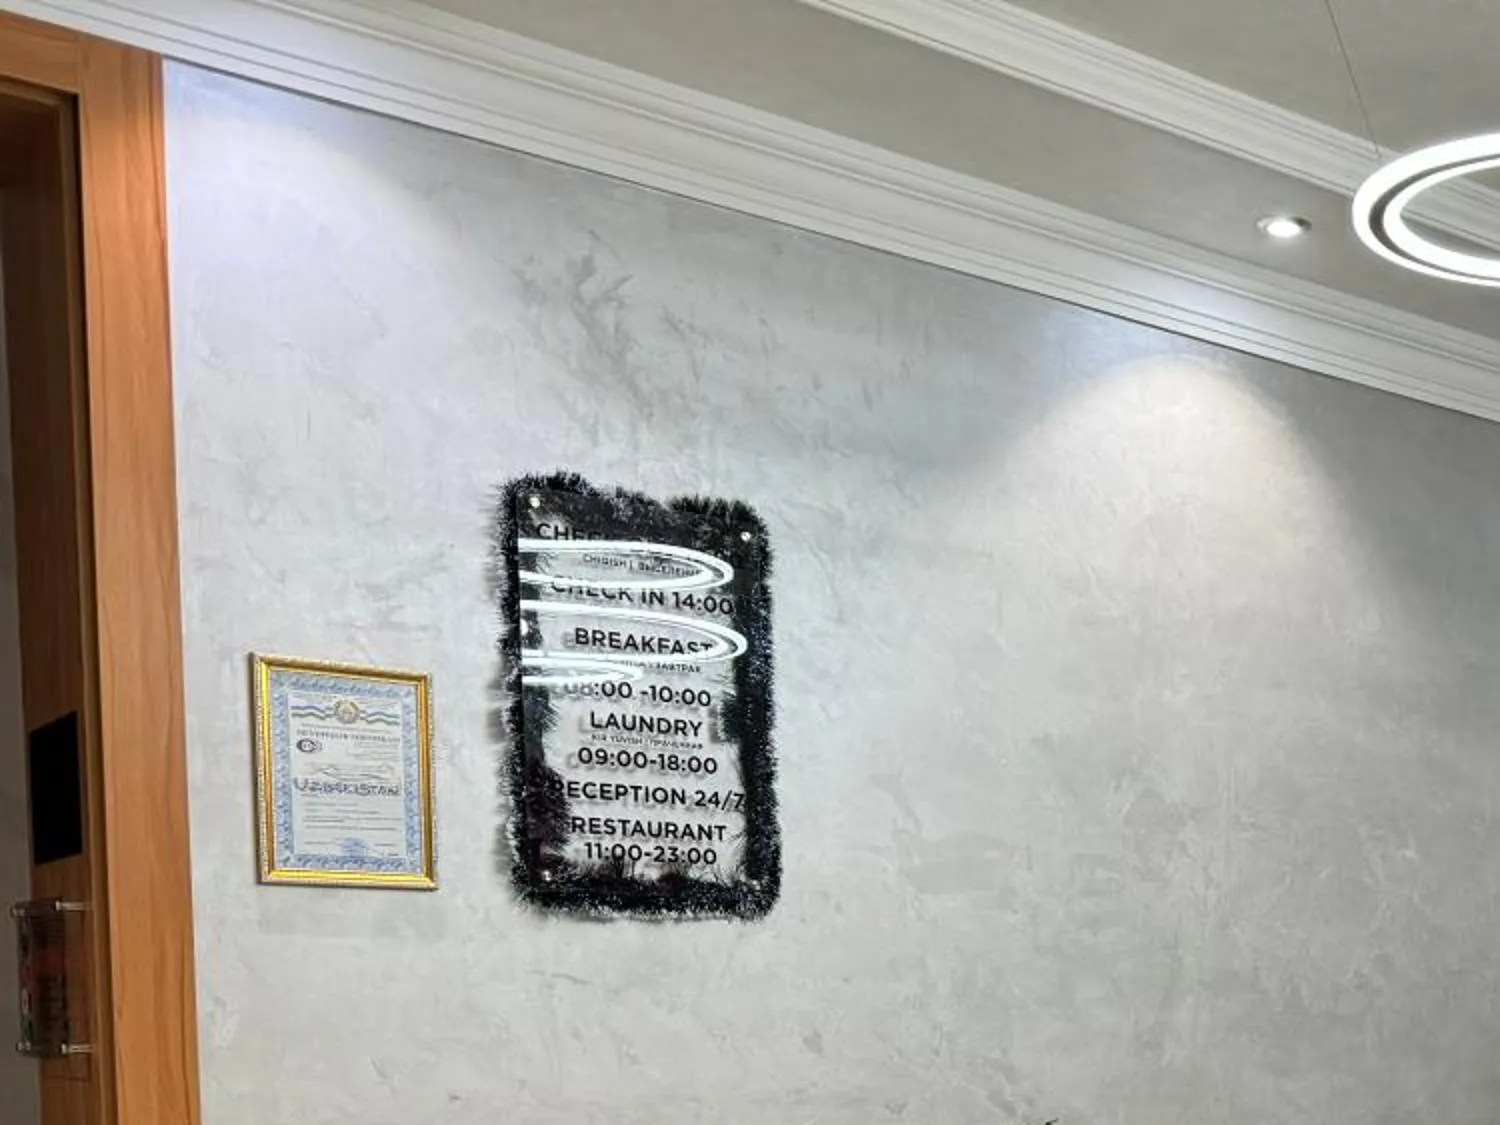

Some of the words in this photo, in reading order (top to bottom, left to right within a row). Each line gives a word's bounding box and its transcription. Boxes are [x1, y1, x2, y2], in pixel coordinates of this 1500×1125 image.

[641, 590, 664, 606] IN
[672, 592, 733, 614] 14:00
[575, 627, 713, 655] BREAKFAST
[590, 710, 703, 737] LAUNDRY
[578, 747, 717, 774] 09:00-18:00
[553, 779, 686, 804] RECEPTION
[694, 790, 744, 810] 24/7
[571, 817, 727, 841] RESTAURANT
[584, 842, 717, 865] 11:00-23:00
